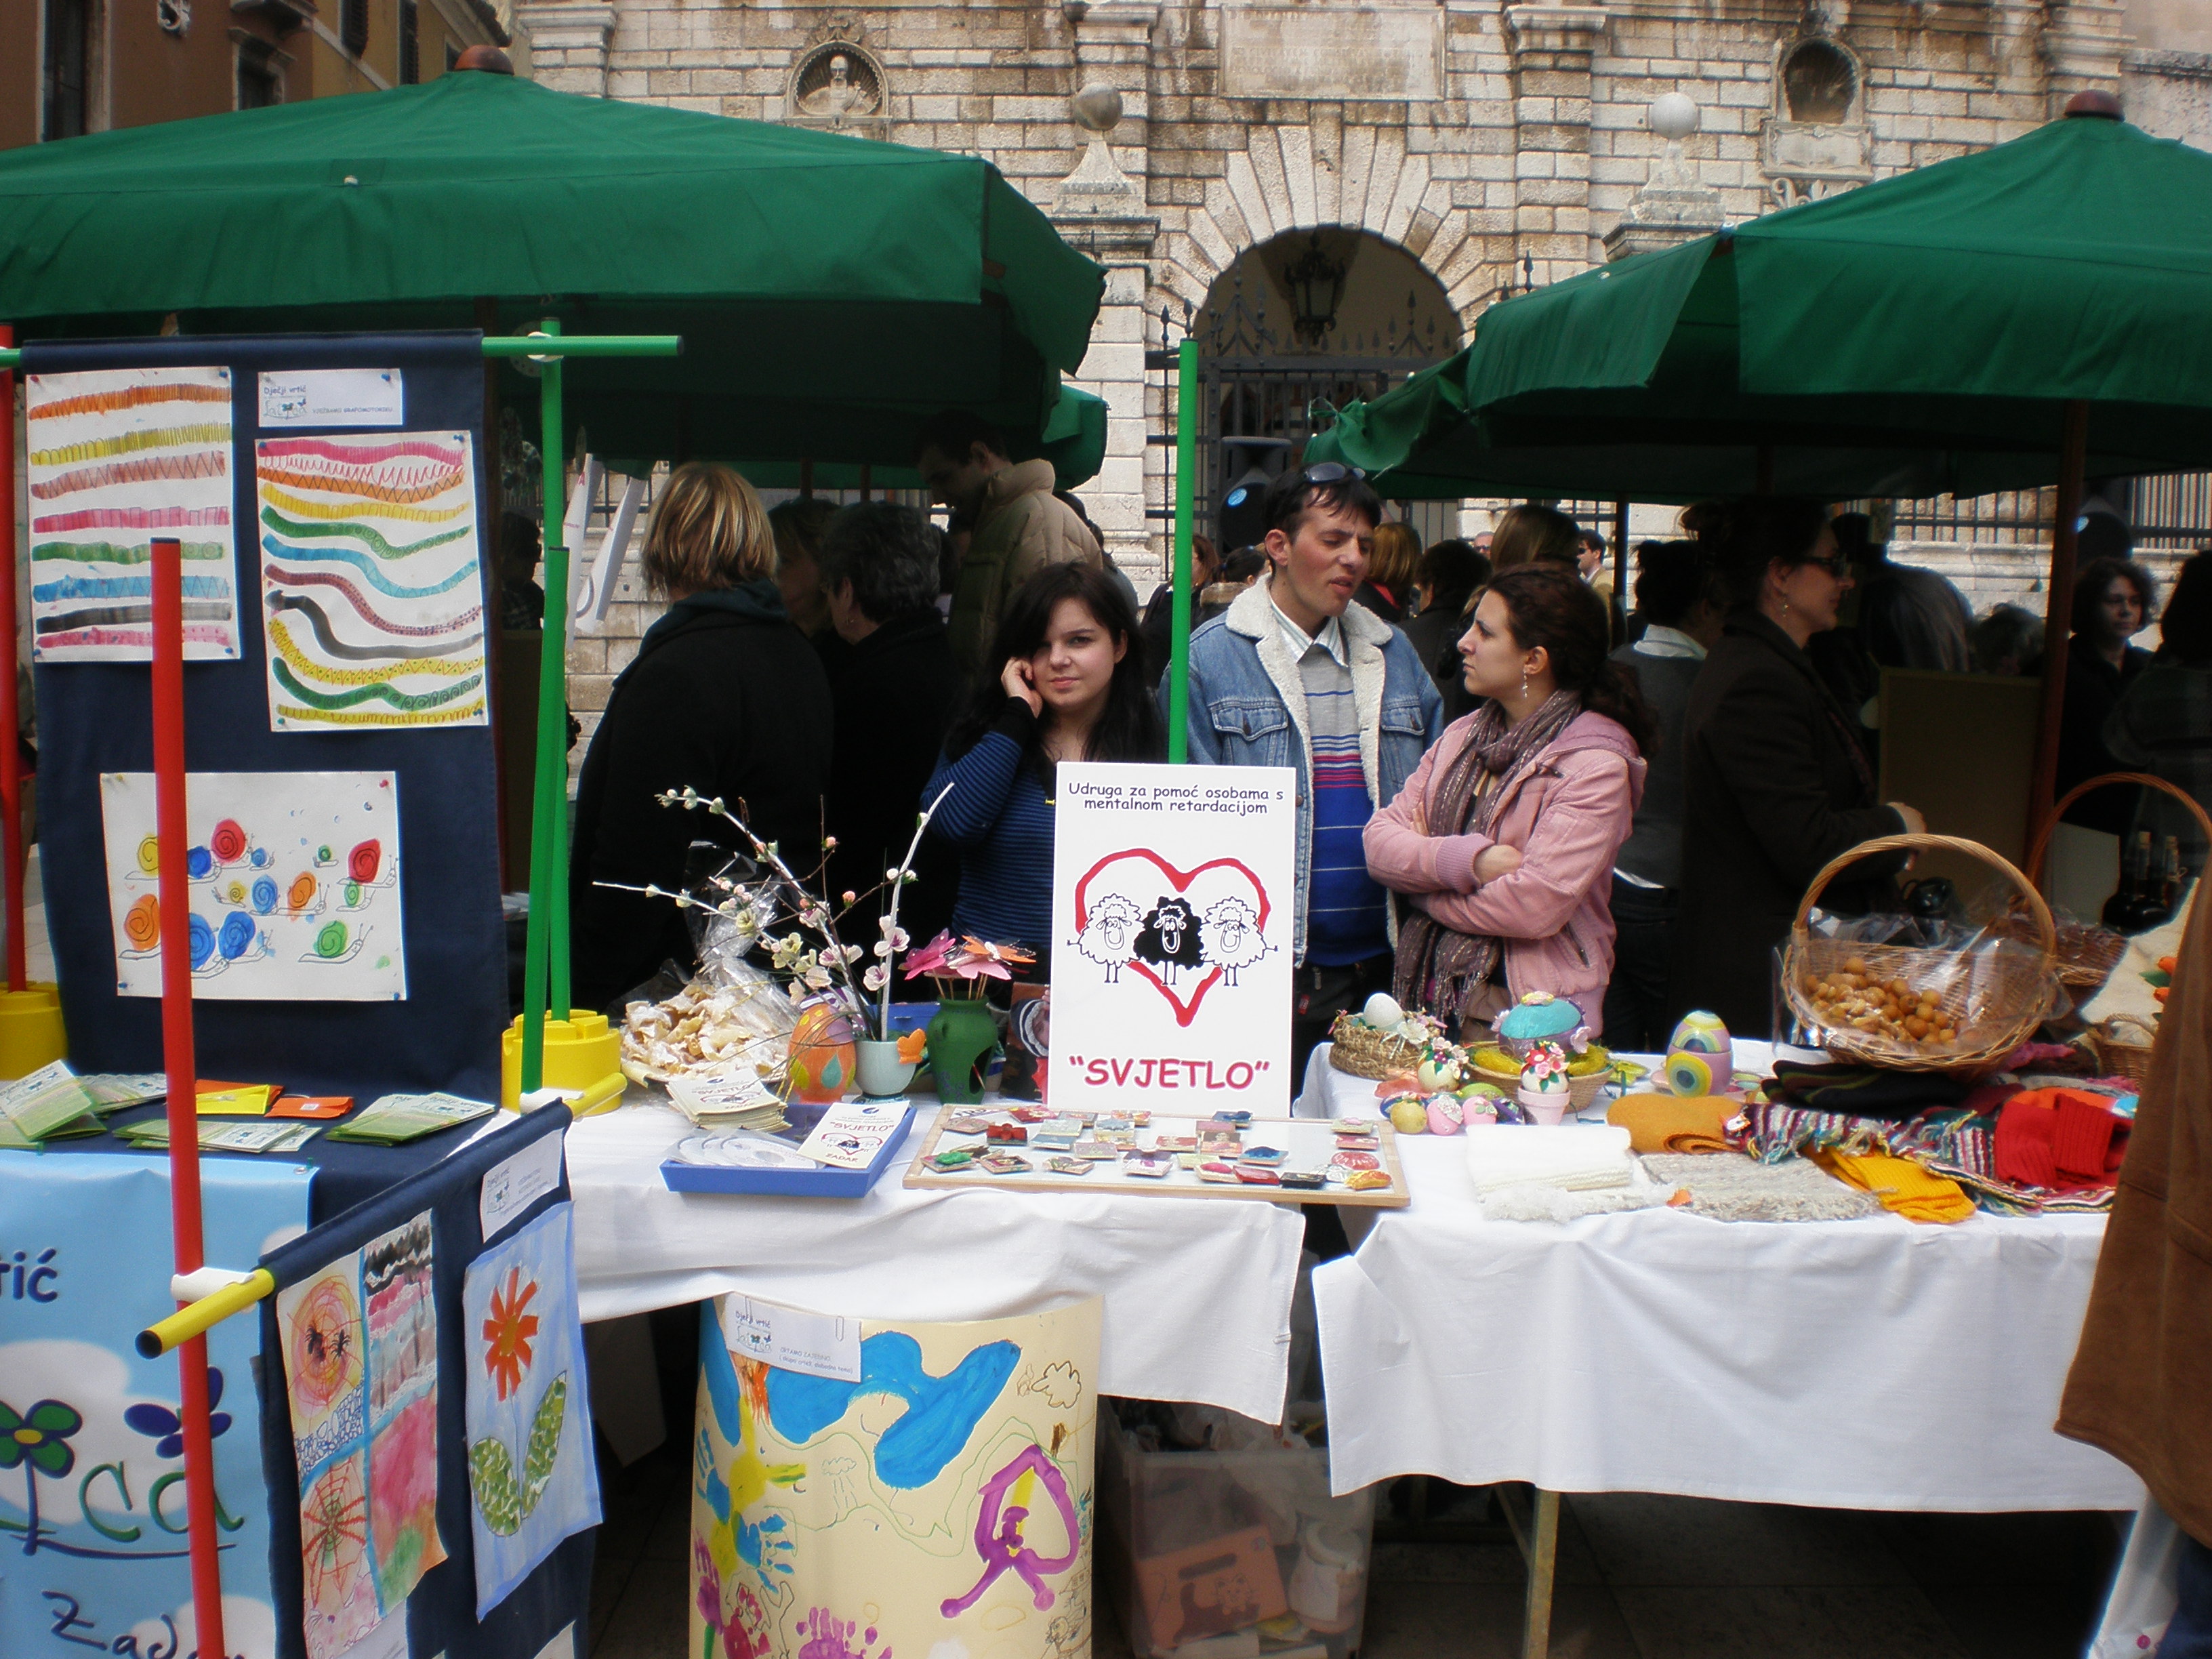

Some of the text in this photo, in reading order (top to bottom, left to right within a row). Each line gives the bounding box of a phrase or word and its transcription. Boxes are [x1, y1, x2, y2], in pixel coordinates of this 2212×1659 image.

[1068, 782, 1284, 800] Udruga za pomoć osobama s
[1084, 798, 1267, 817] mentalnom retardacijom
[1069, 1055, 1270, 1090] "SVJETLO"
[0, 1247, 58, 1303] ić
